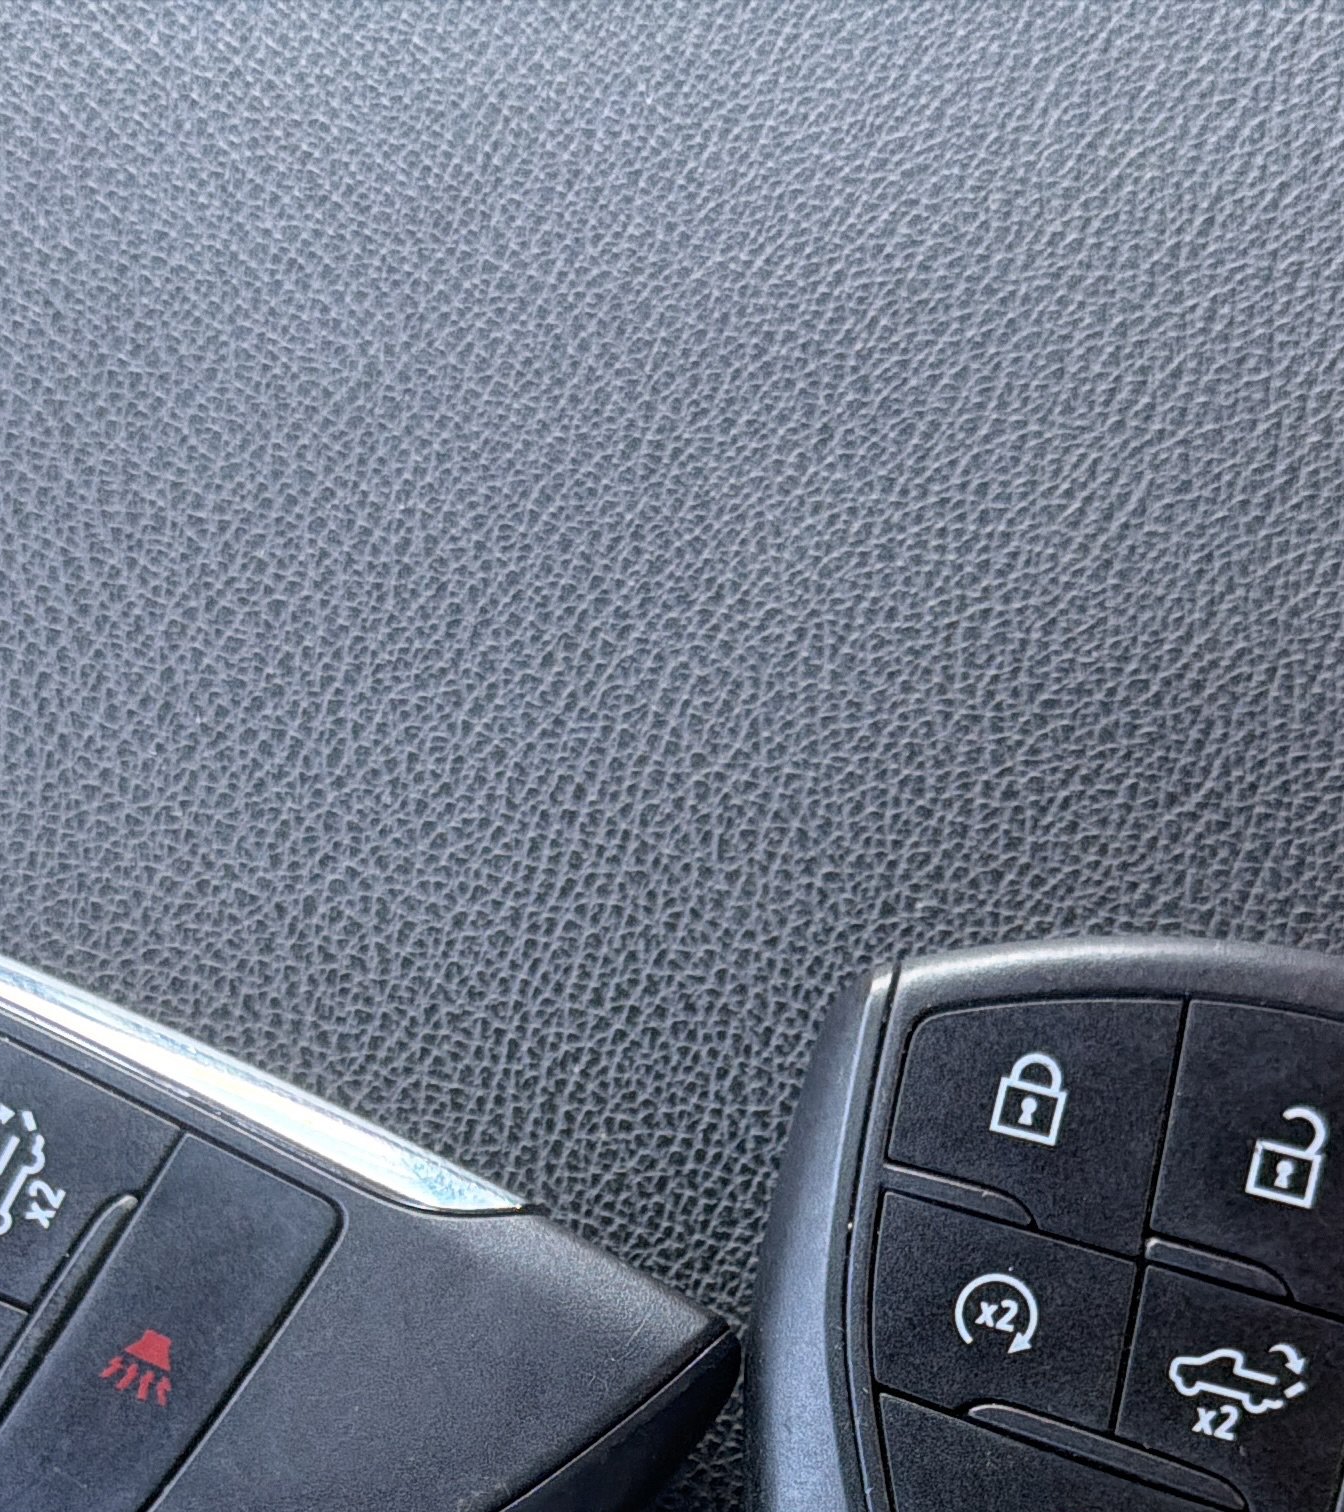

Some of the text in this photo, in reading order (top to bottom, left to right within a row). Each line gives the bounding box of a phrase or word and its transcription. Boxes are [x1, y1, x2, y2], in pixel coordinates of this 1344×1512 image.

[27, 1180, 65, 1228] x2
[975, 1299, 1020, 1333] x2
[1192, 1406, 1240, 1442] x2
